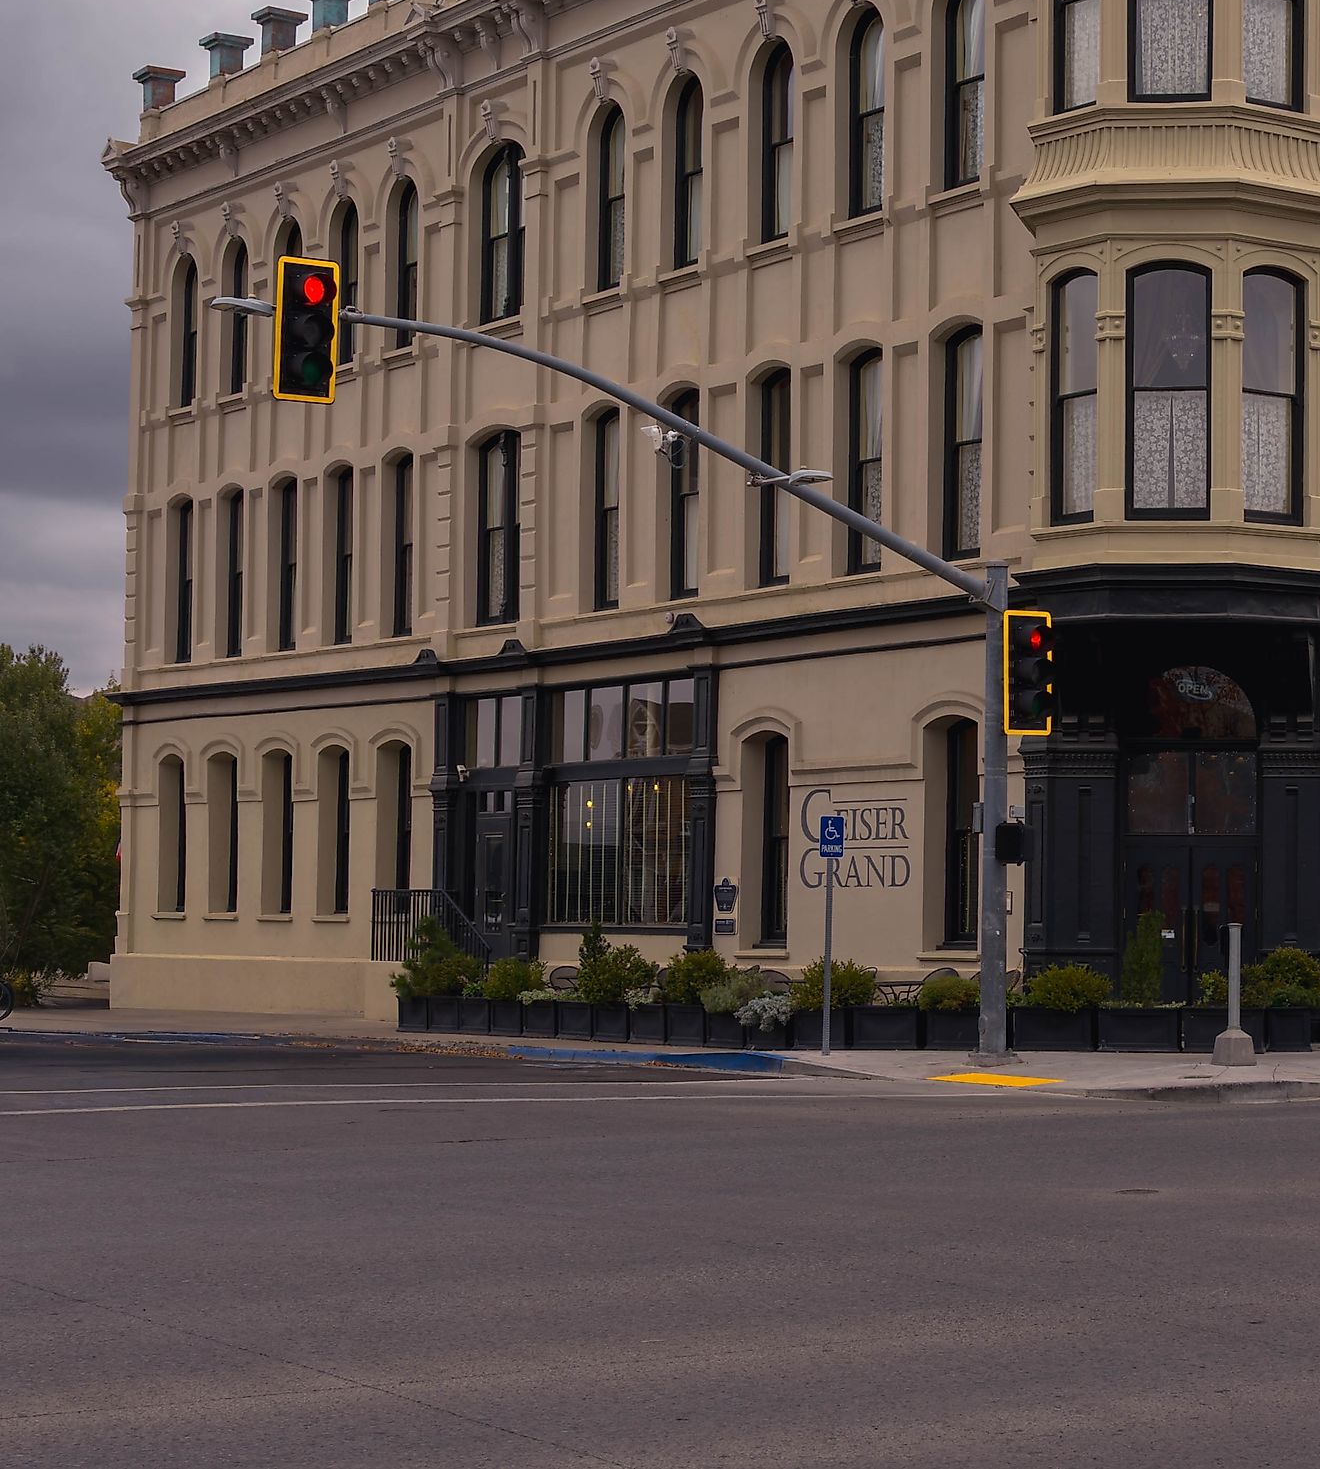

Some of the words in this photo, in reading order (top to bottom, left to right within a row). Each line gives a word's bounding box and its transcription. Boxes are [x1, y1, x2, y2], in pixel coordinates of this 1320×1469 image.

[1178, 683, 1209, 694] OPEN
[821, 844, 843, 854] PARKING
[800, 848, 911, 889] GRAND
